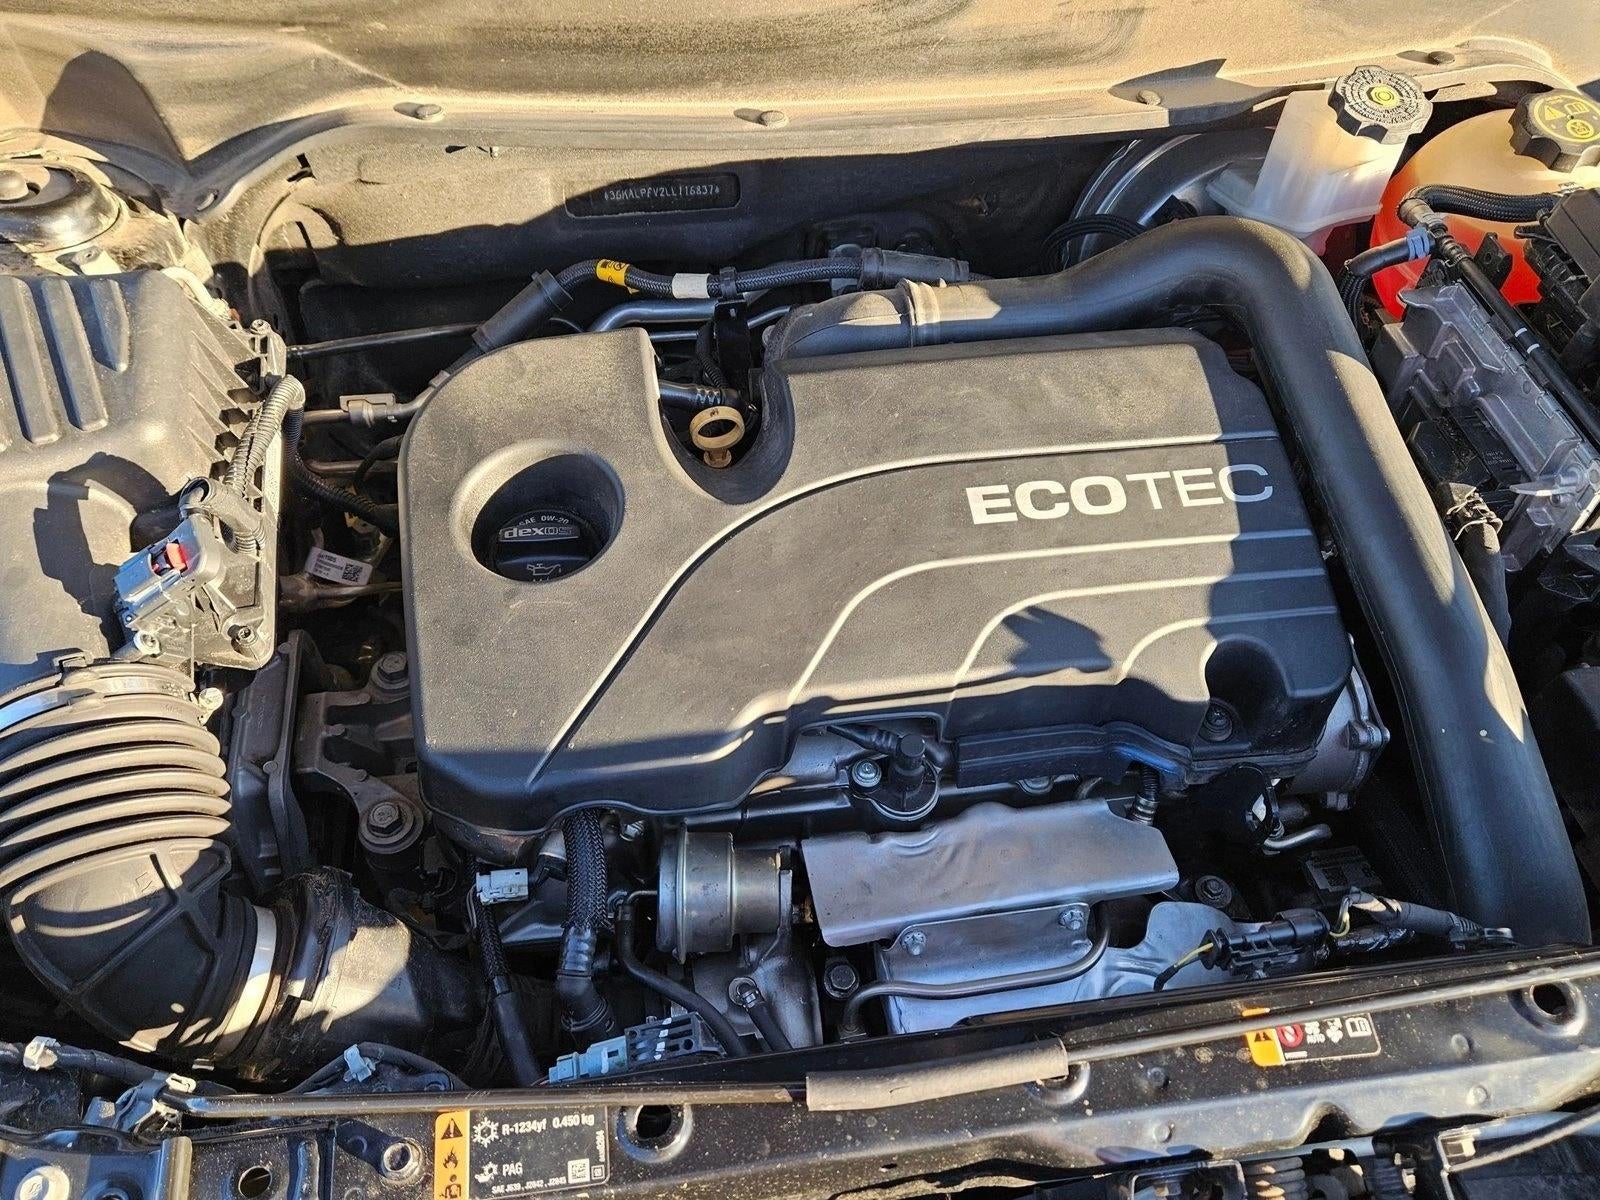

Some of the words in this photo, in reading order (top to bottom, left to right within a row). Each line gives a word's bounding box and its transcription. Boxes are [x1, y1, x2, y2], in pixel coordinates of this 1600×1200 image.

[965, 463, 1274, 525] ECOTEC
[502, 1118, 546, 1136] R-1234yf
[552, 1114, 580, 1129] 0.450
[580, 1113, 595, 1127] kg
[502, 1162, 523, 1177] PAG
